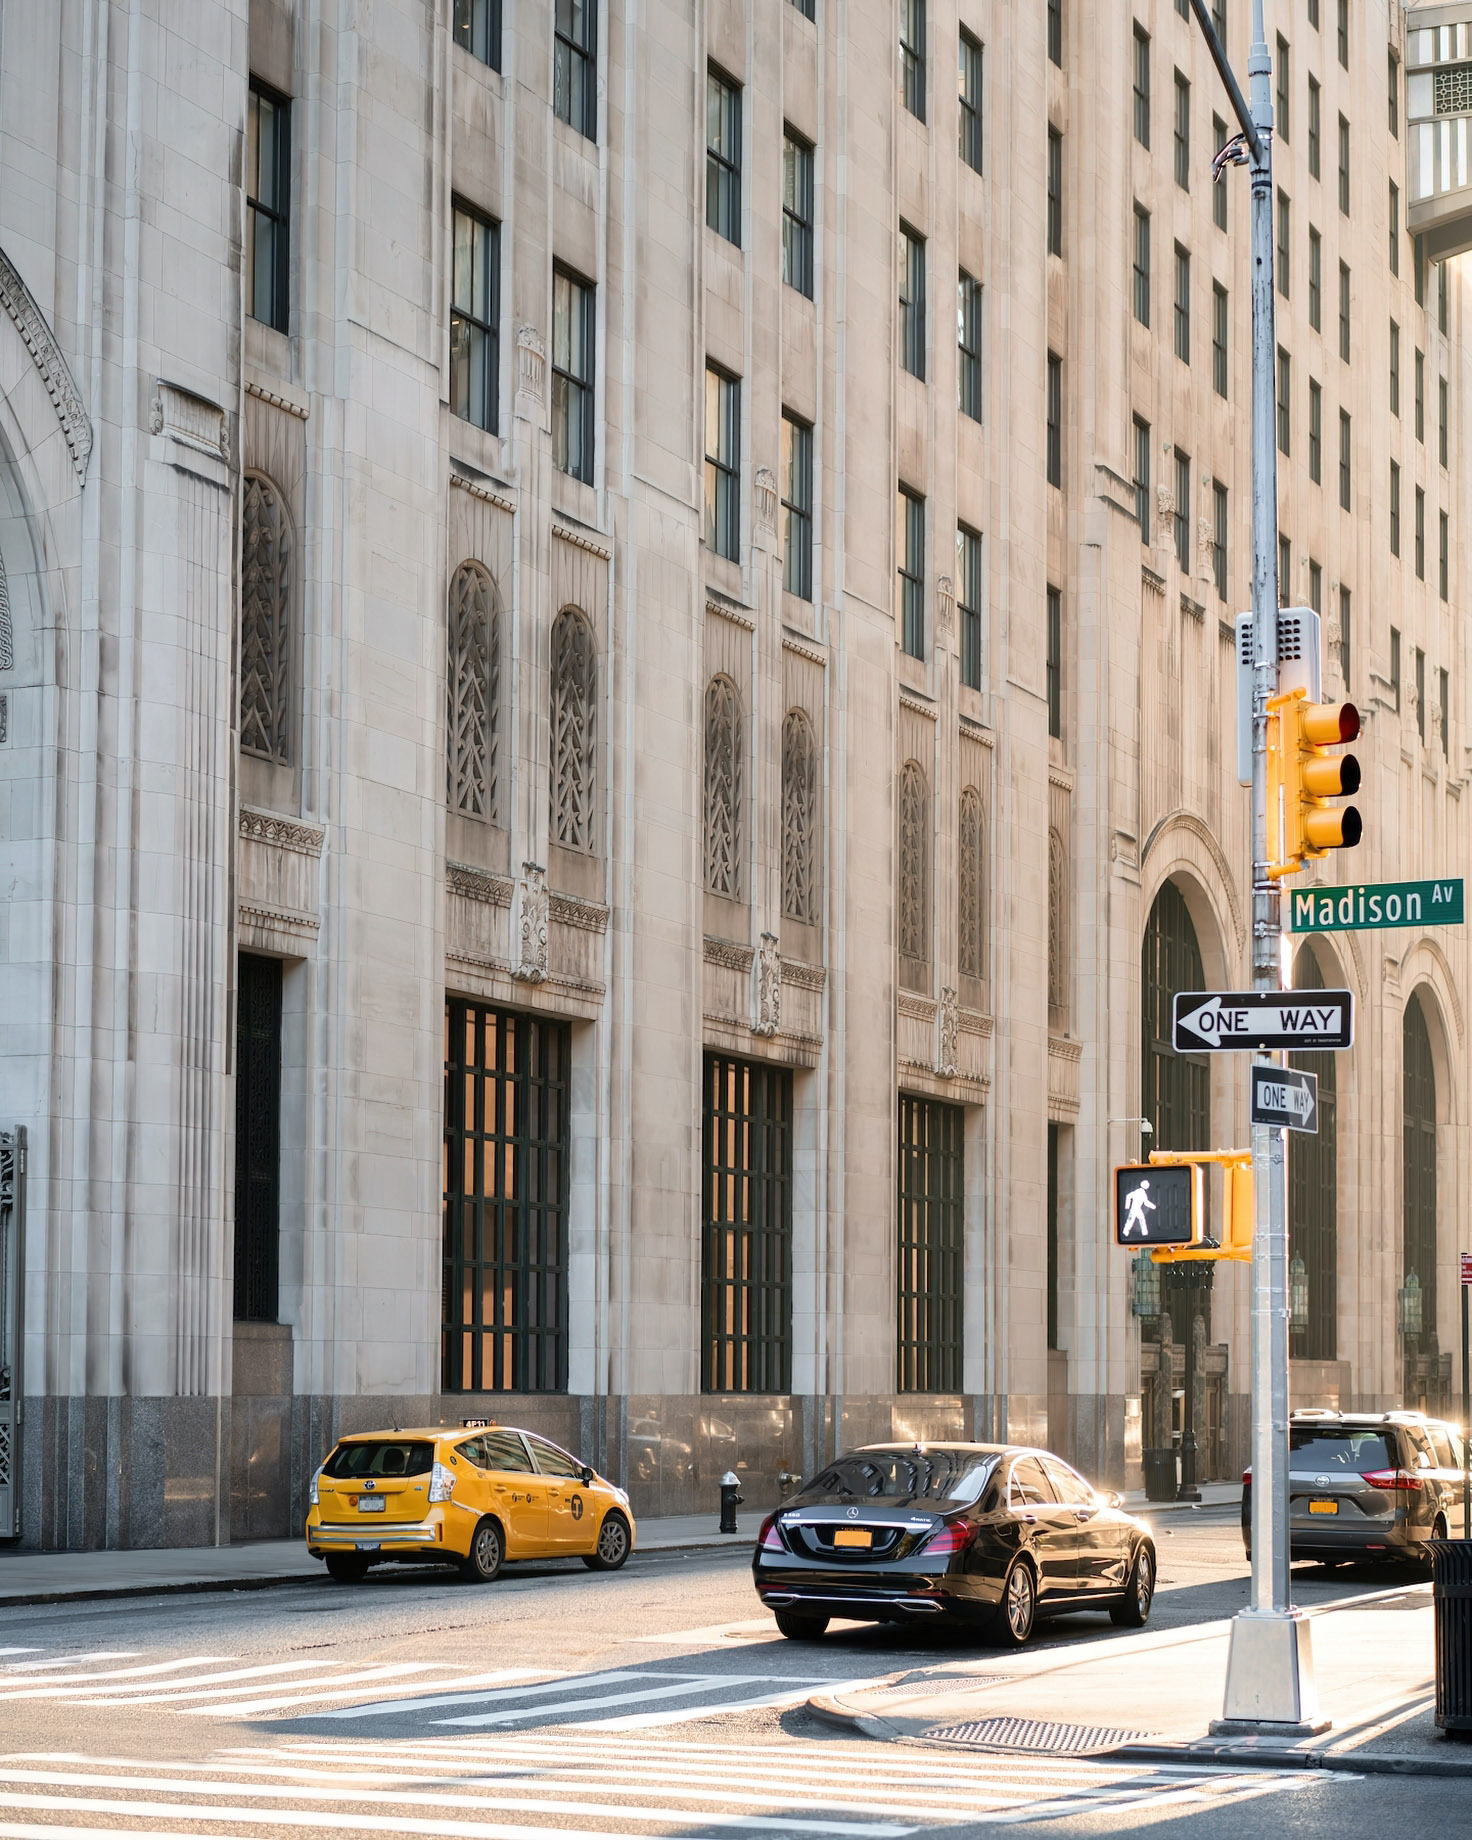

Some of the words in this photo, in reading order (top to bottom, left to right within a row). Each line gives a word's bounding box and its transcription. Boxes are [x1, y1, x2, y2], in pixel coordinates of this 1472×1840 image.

[1295, 887, 1422, 926] Madison
[1432, 883, 1454, 903] Av
[1198, 1011, 1249, 1033] ONE
[1280, 1009, 1336, 1031] WAY
[1263, 1085, 1287, 1109] ONE
[1293, 1089, 1310, 1113] WAY
